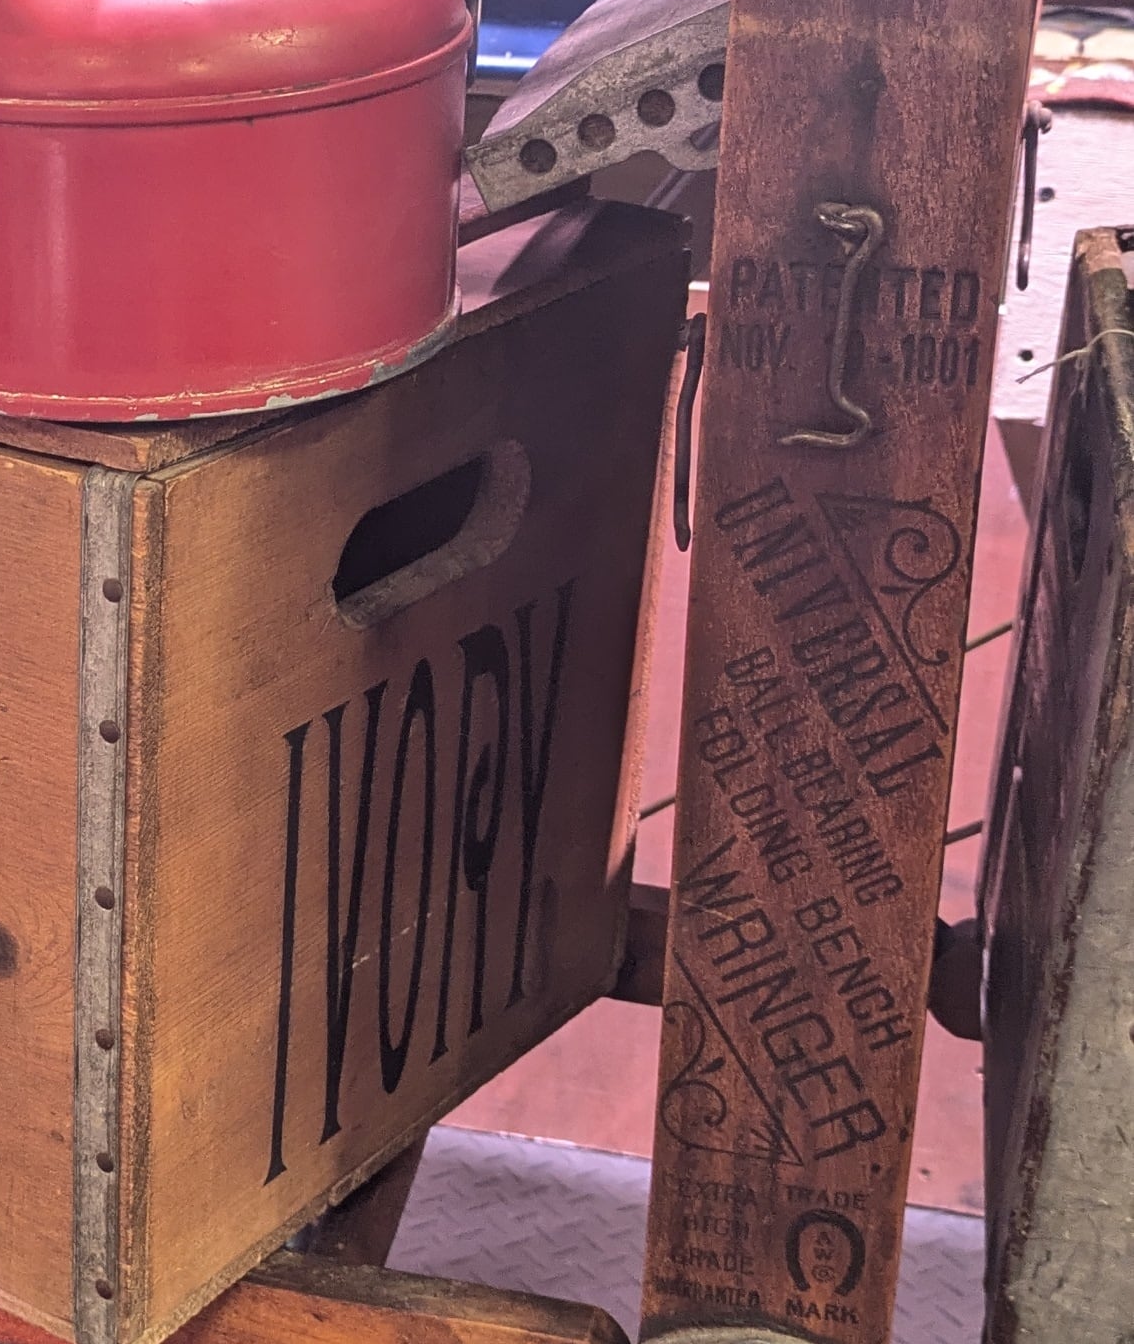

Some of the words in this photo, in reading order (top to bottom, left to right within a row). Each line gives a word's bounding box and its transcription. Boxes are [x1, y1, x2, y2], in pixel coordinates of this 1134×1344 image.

[714, 476, 945, 796] UNIVERSAL
[723, 645, 811, 750] BALL
[780, 747, 904, 906] BEARING
[263, 577, 580, 1187] IVORY
[675, 834, 888, 1161] WRINGER
[693, 706, 814, 885] FOLDING
[793, 895, 913, 1052] BENCH
[785, 1184, 869, 1212] TRADE
[785, 1297, 860, 1325] MARK
